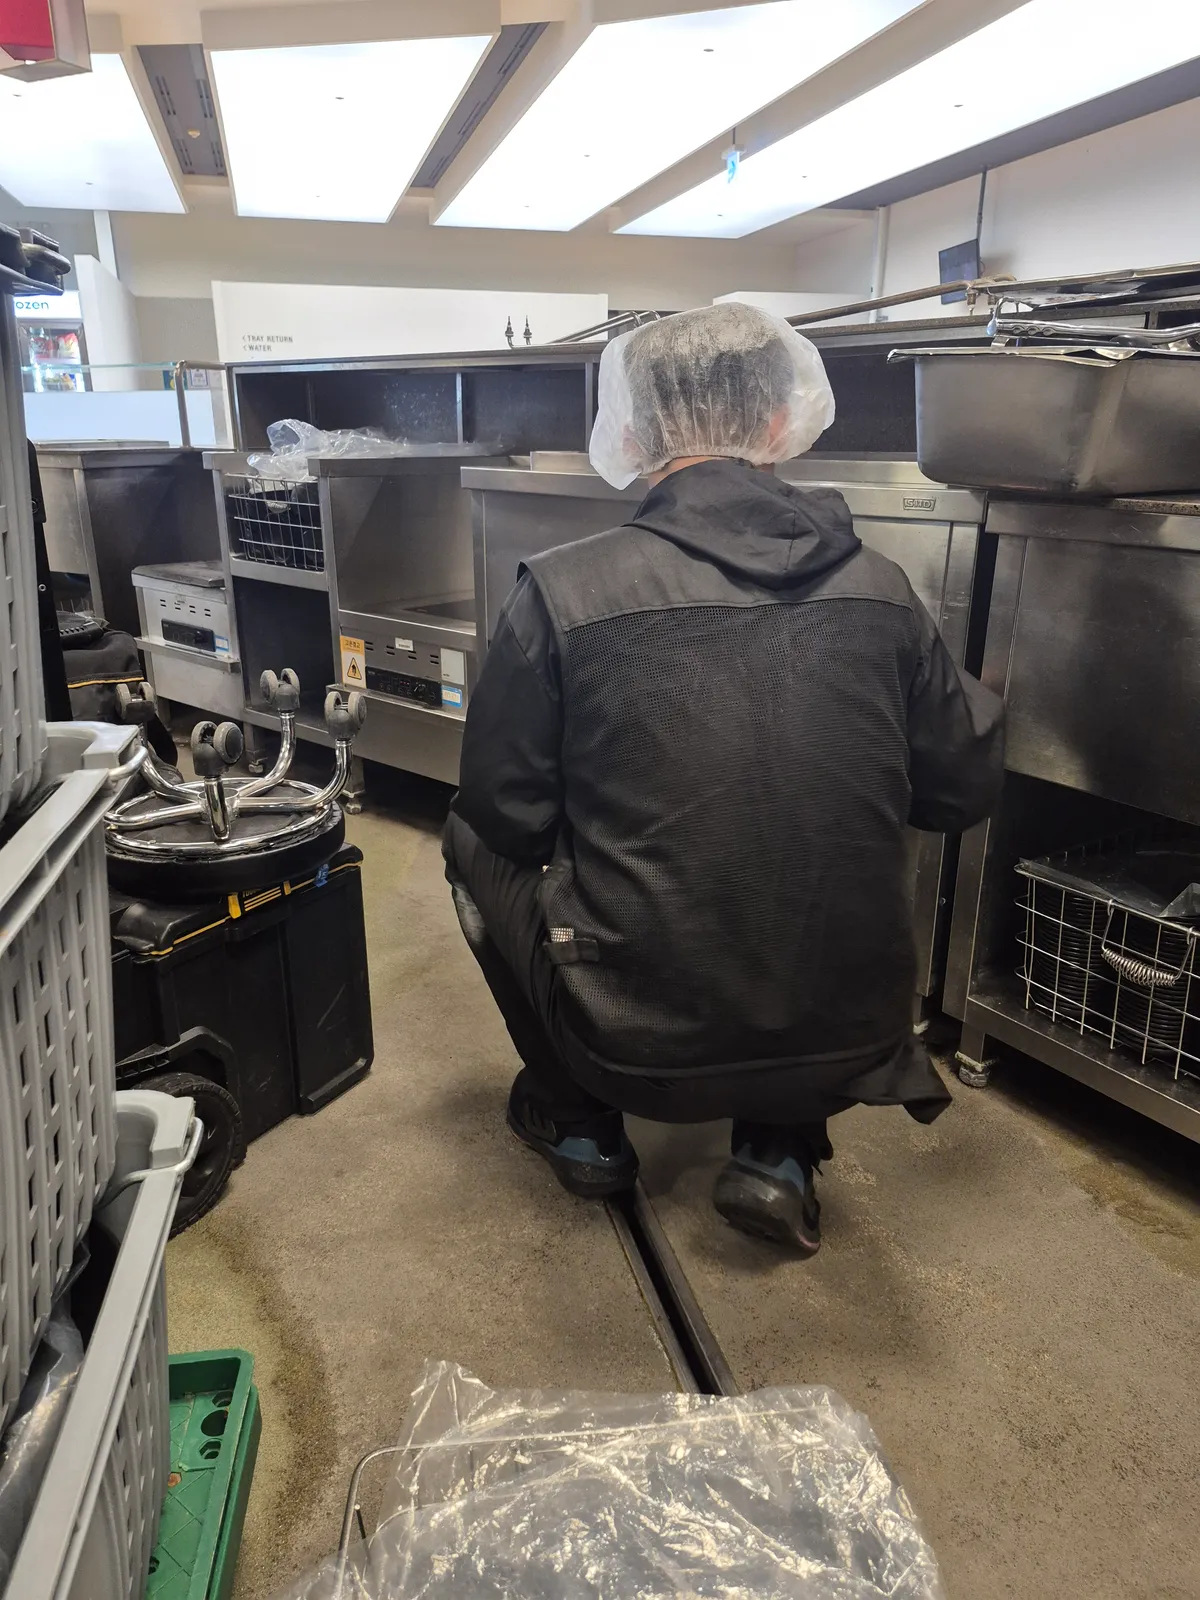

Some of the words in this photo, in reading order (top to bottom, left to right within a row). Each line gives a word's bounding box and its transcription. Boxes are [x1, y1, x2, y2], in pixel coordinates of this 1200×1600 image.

[15, 301, 50, 310] ozen
[247, 334, 264, 342] TRAY
[266, 335, 293, 343] RETURN
[248, 344, 272, 352] WATER
